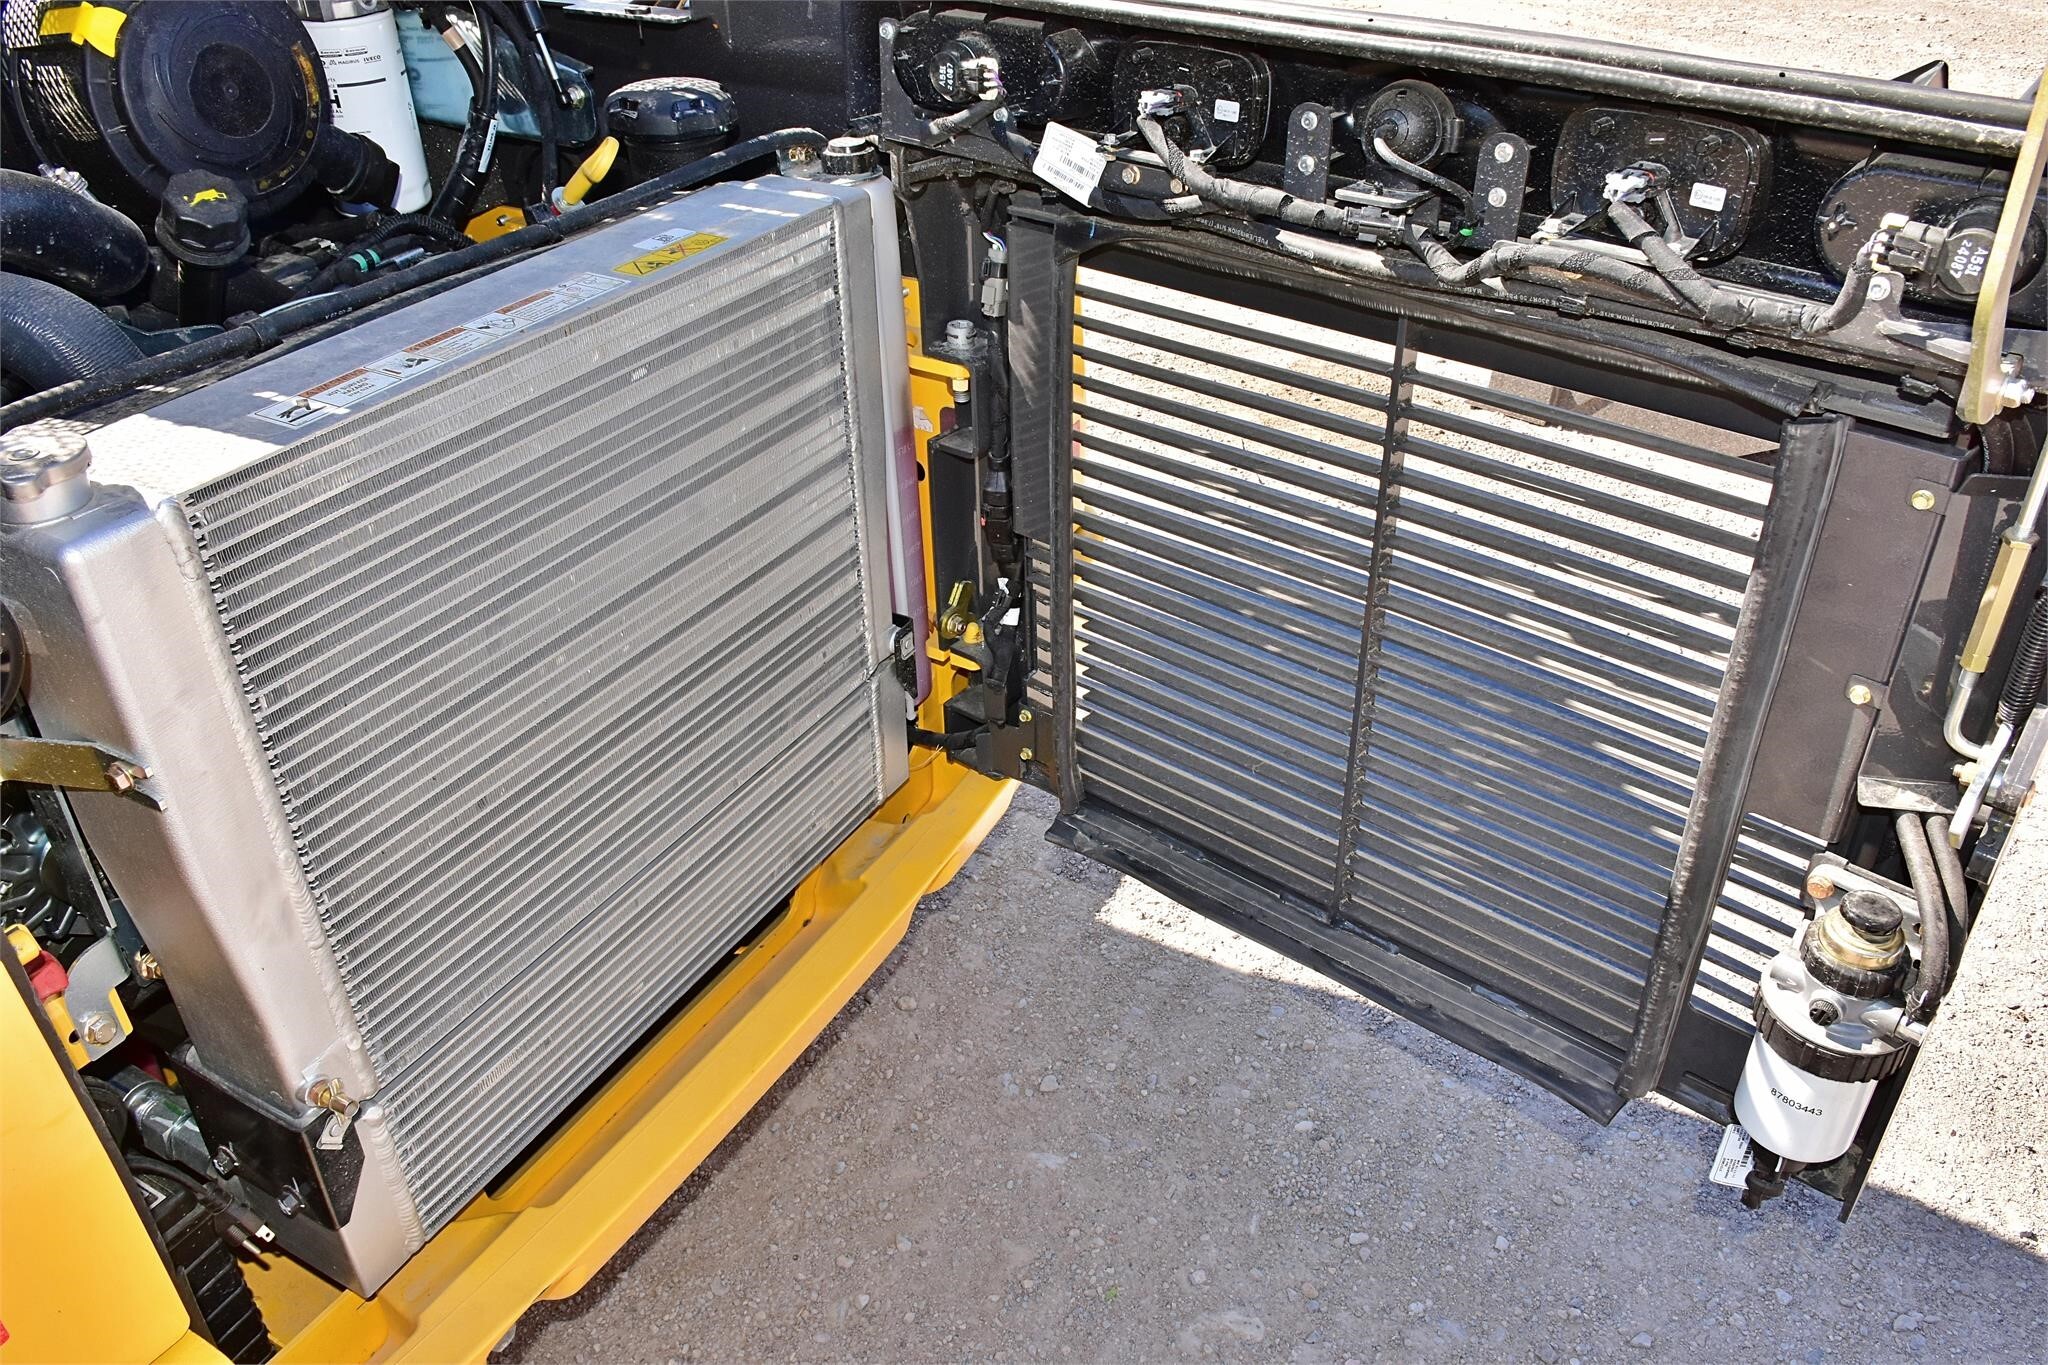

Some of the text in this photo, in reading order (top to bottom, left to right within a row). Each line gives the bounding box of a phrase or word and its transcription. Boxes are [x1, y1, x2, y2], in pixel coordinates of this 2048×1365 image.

[363, 54, 381, 62] IVECO
[946, 62, 954, 91] 24087
[1950, 240, 1972, 279] 24087
[1770, 1087, 1823, 1117] 87803443
